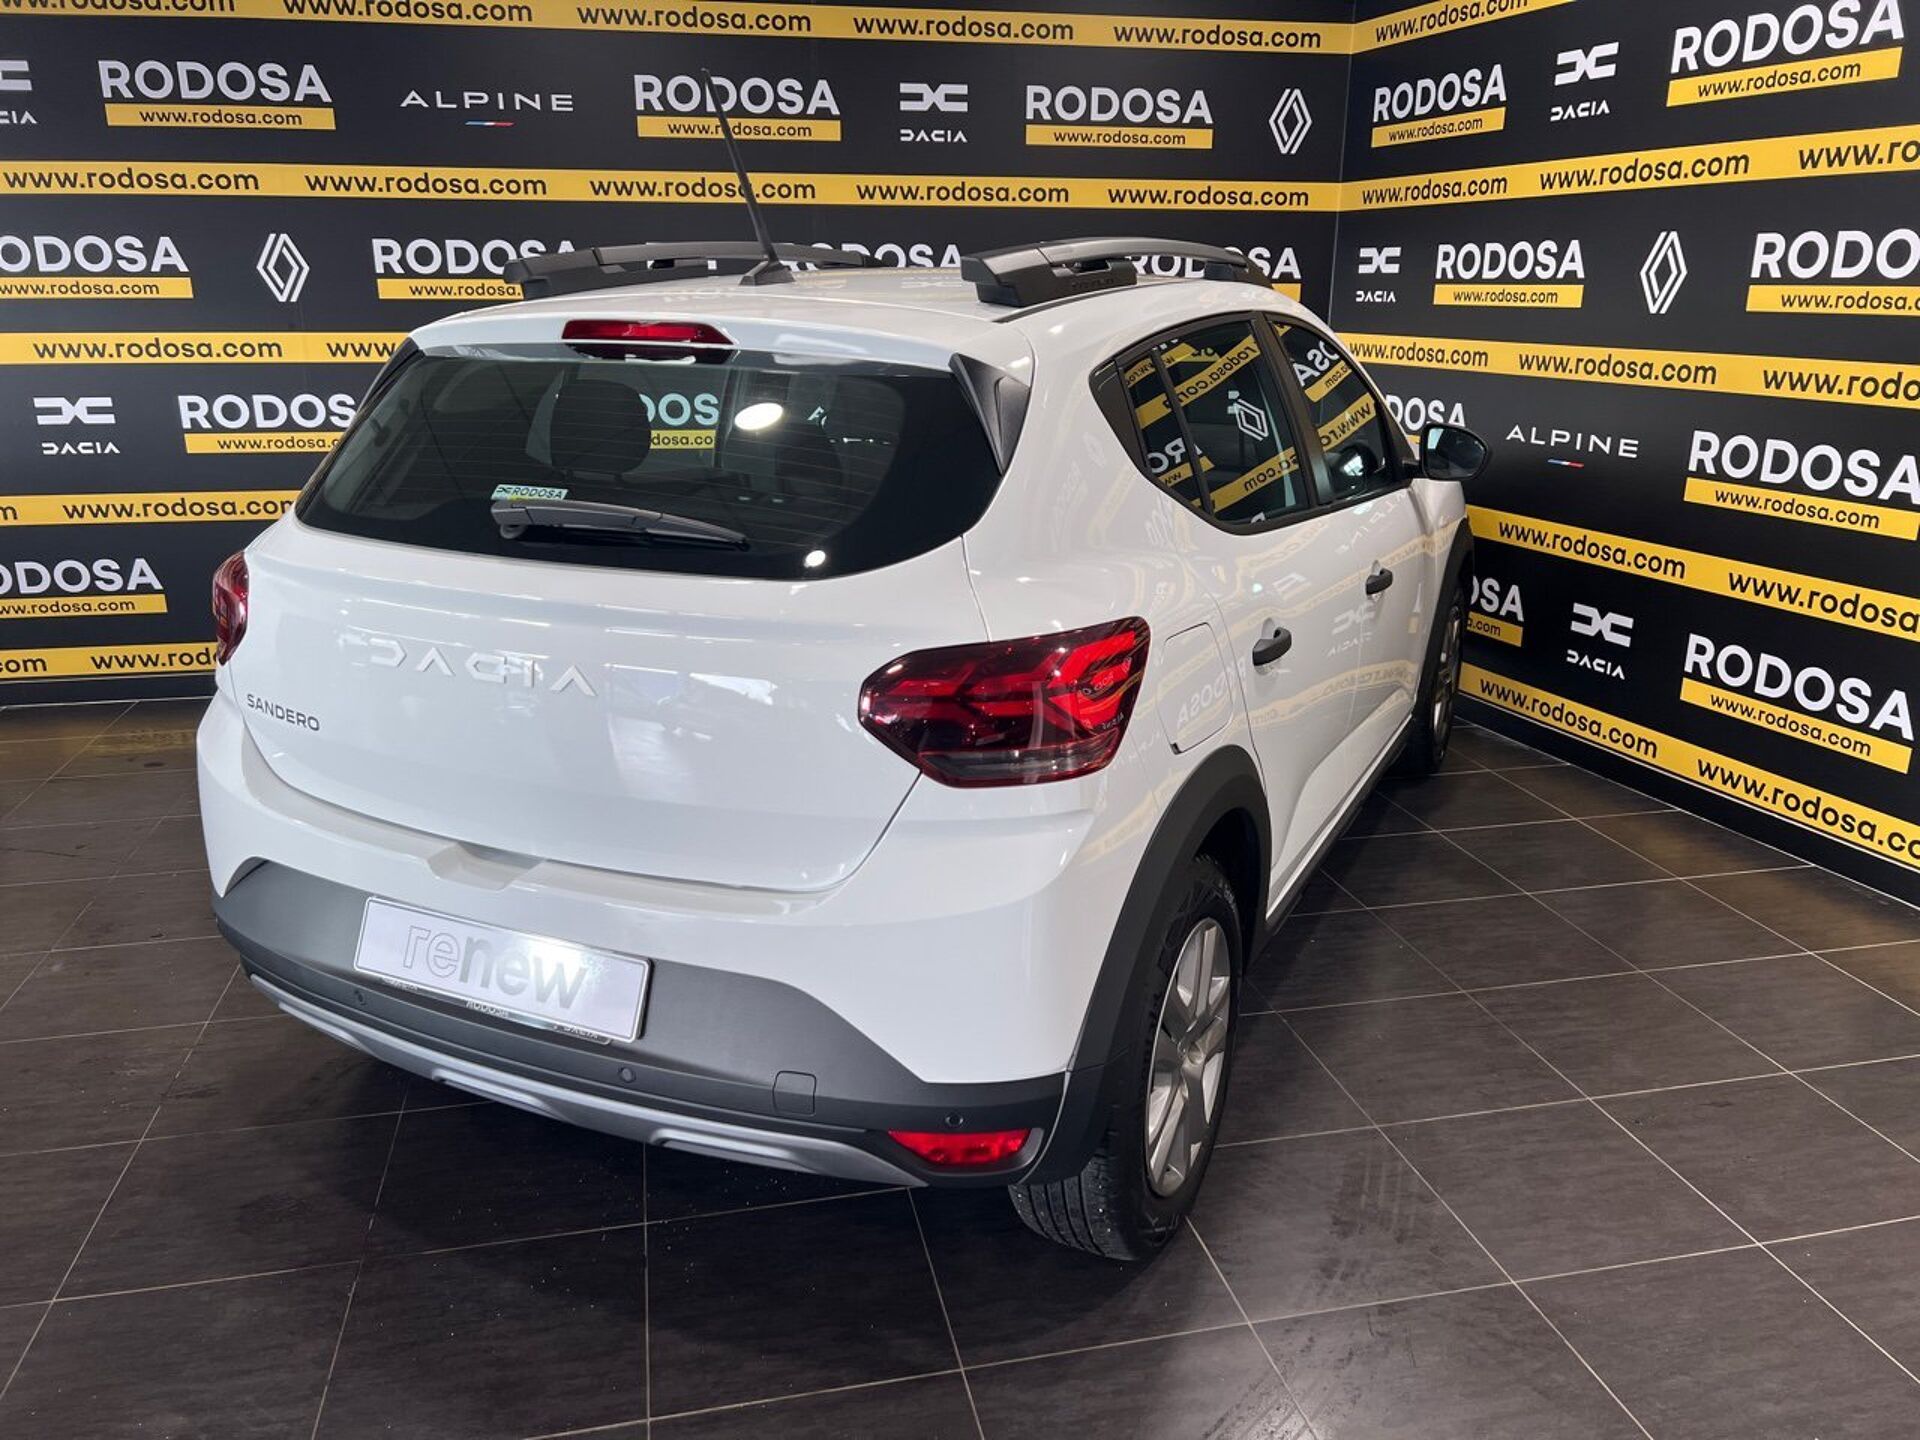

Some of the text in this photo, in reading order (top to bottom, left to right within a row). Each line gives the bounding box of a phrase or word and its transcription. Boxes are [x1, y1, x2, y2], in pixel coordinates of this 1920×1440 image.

[285, 0, 533, 22] www.rodosa.com
[577, 5, 811, 32] www.rodosa.com
[853, 14, 1074, 40] www.rodosa.com
[1113, 24, 1321, 48] www.rodosa.com
[1670, 0, 1905, 74] RODOSA
[98, 60, 333, 103] RODOSA
[634, 73, 840, 116] RODOSA
[1372, 64, 1507, 123] RODOSA
[1697, 63, 1861, 98] www.rodosa.com
[139, 108, 303, 126] www.rodosa.com
[400, 90, 574, 112] ALPINE
[1025, 85, 1213, 124] RODOSA
[1550, 100, 1611, 122] DACIA
[668, 122, 813, 138] www.rdosa.com
[900, 129, 968, 144] DACIA
[1053, 129, 1186, 146] www.rodosa.com
[1388, 117, 1483, 142] www.rodosa.com
[3, 167, 260, 191] www.rodosa.com
[304, 171, 547, 195] www.rodosa.com
[856, 181, 1069, 204] www.rodosa.com
[1108, 185, 1309, 207] www.rodosa.com
[1362, 175, 1508, 205] www.rodosa.com
[1539, 153, 1750, 190] www.rodosa.com
[1435, 239, 1585, 280] RODOSA
[1751, 228, 1920, 280] RODO
[1355, 290, 1396, 303] DACIA
[1453, 287, 1558, 304] www.rodosa.com
[33, 336, 283, 359] www.rodosa.com
[1349, 341, 1920, 402] www.rodosa.com www.rodosa.com www.rodo
[41, 442, 121, 455] DACIA
[1505, 425, 1639, 459] ALPINE
[1688, 430, 1920, 505] RODOSA
[511, 486, 563, 499] RODOSA
[1715, 488, 1880, 530] www.rodosa.com
[1499, 521, 1920, 634] www.rodosa.com www.rodosa
[1566, 648, 1626, 681] DACIA
[1684, 633, 1914, 741] RODOSA
[246, 693, 321, 732] SANDERO
[1479, 675, 1658, 759] www.rodosa.com
[1710, 692, 1872, 757] www.rodosa.com
[402, 924, 589, 1010] renew
